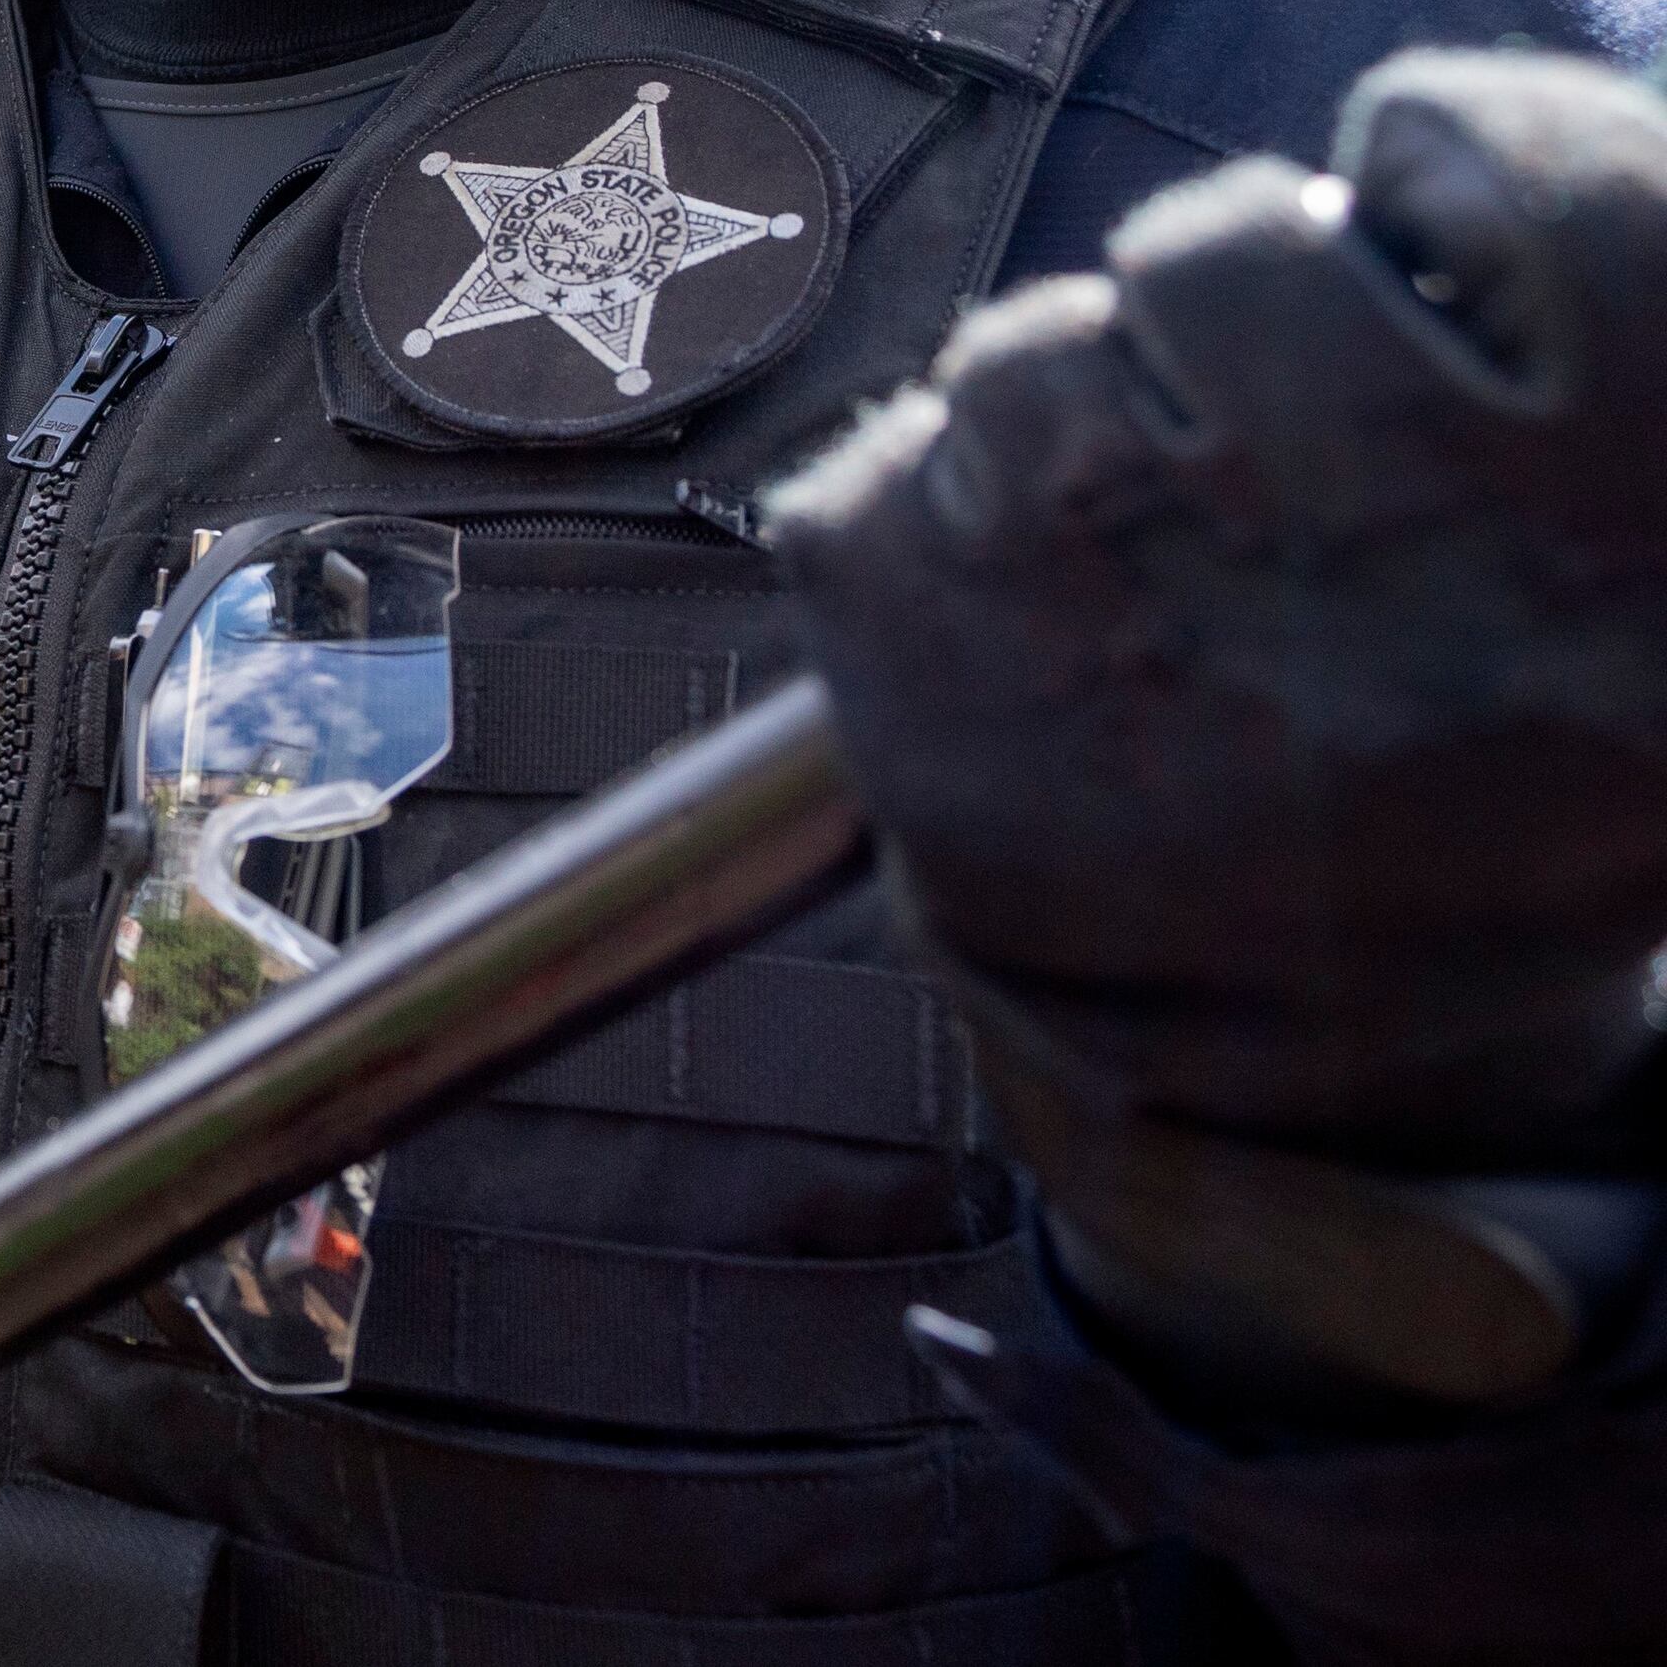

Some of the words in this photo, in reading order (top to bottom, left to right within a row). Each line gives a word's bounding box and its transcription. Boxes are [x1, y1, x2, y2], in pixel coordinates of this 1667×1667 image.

[493, 175, 570, 263] OREGON
[581, 170, 663, 204] STATE
[631, 208, 680, 290] POLICE
